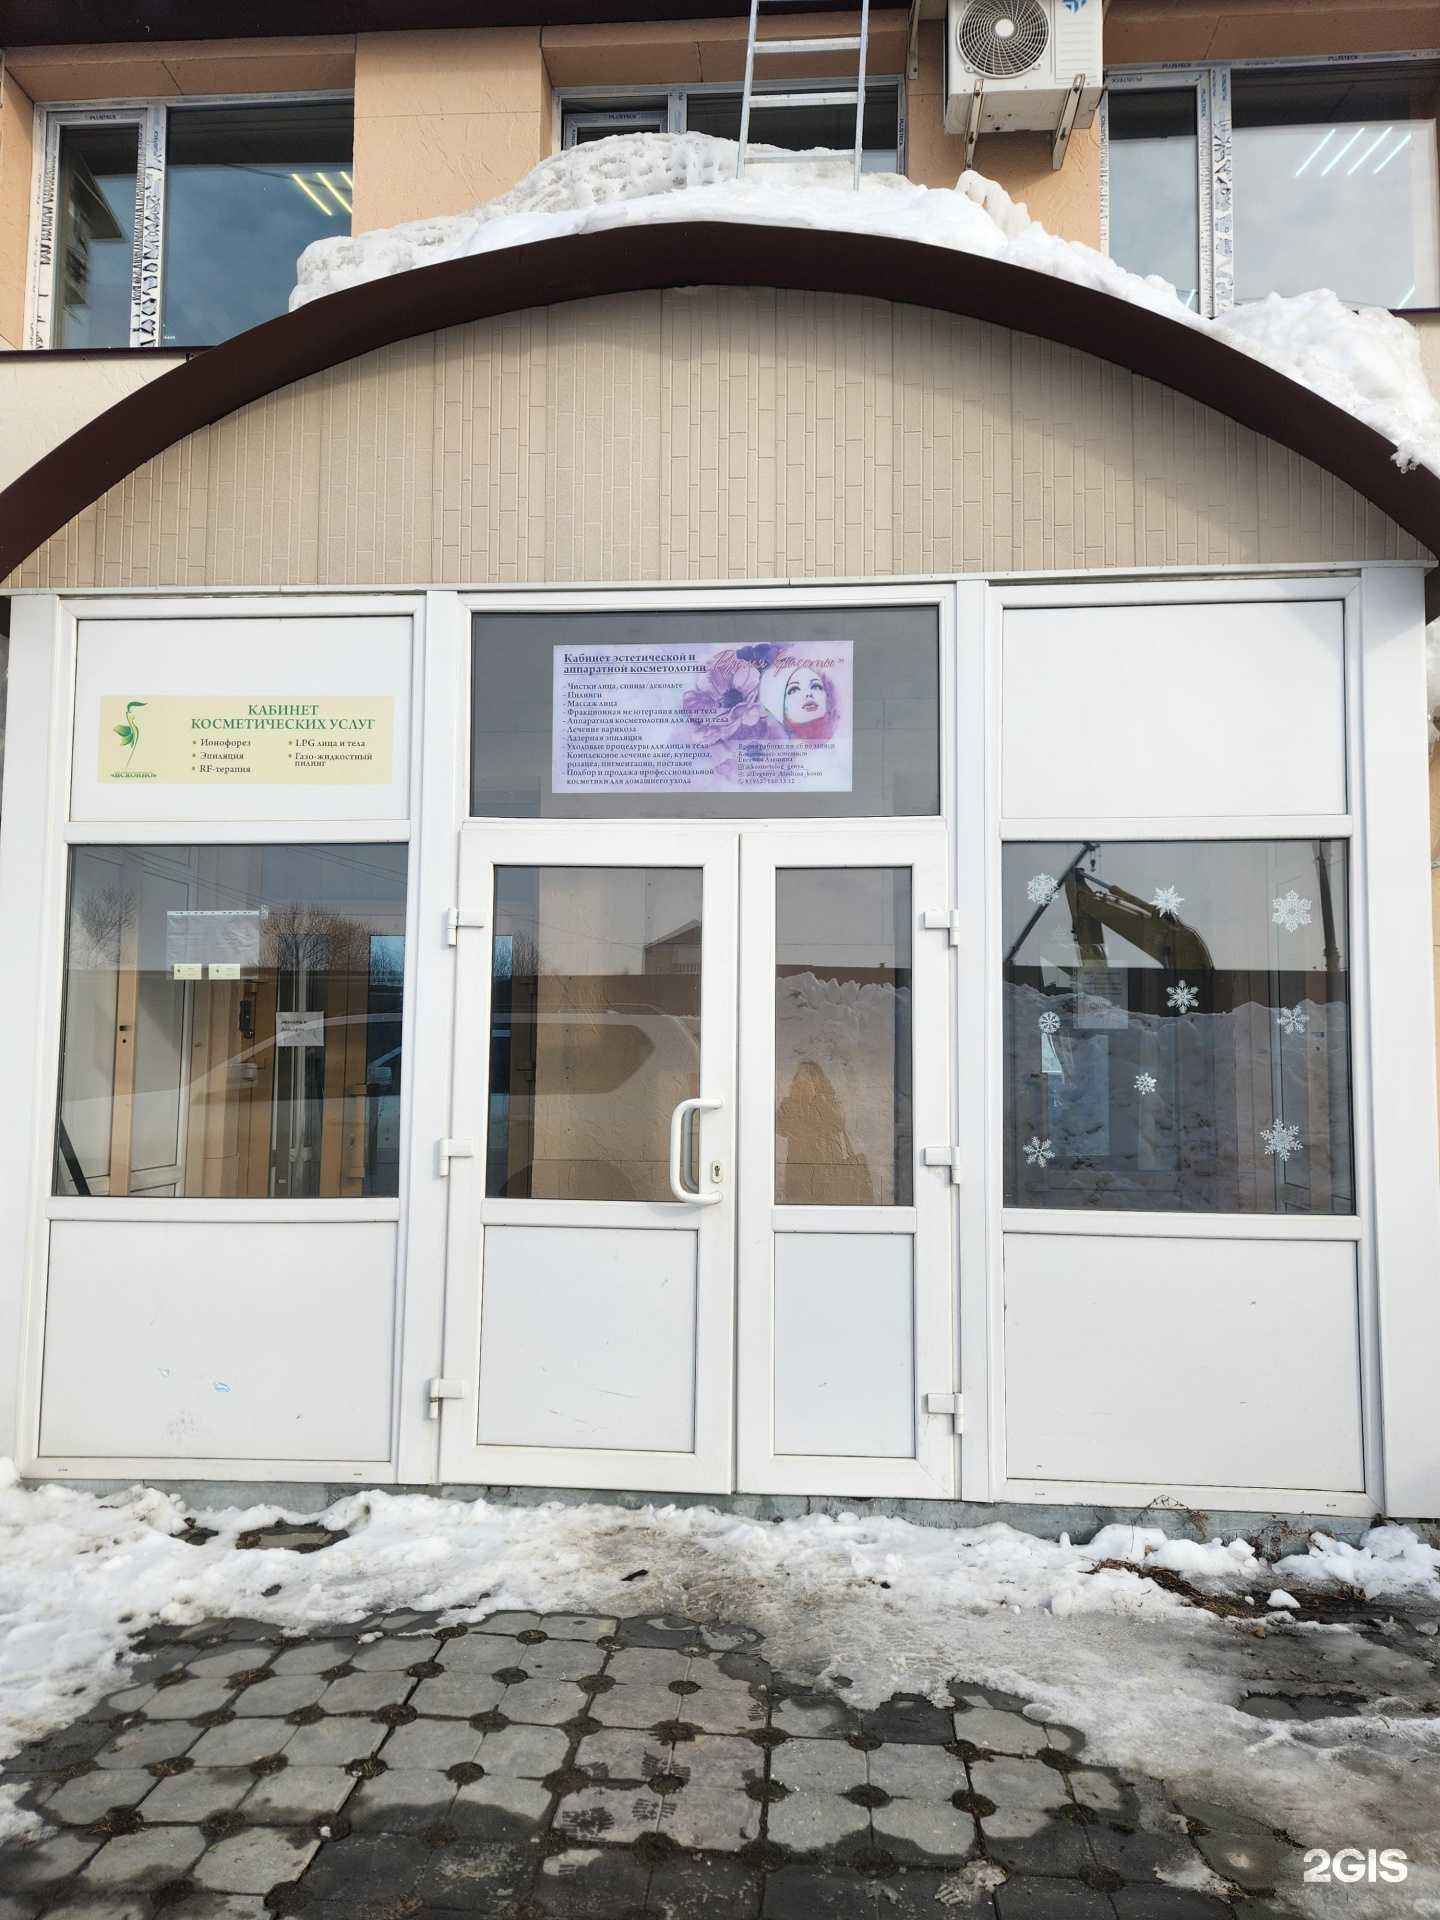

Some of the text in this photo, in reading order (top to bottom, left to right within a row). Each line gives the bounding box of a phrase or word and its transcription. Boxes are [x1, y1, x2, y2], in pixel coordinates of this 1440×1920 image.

[564, 653, 609, 663] Кабинет
[613, 653, 684, 662] эстетической
[563, 664, 706, 675] аппаратной косметологии
[568, 682, 597, 690] Чистки
[567, 691, 602, 699] Пилинги
[248, 704, 320, 715] КАБИНЕТ
[192, 718, 376, 729] КОСМЕТИЧЕСКИХ УСЛУГ
[201, 738, 251, 748] Ионофорез
[296, 738, 315, 747] LPG
[200, 751, 244, 760] Эпиляция
[295, 752, 373, 761] Газо-жидкостный
[200, 764, 251, 774] RF-терапия
[567, 768, 596, 777] Подбор
